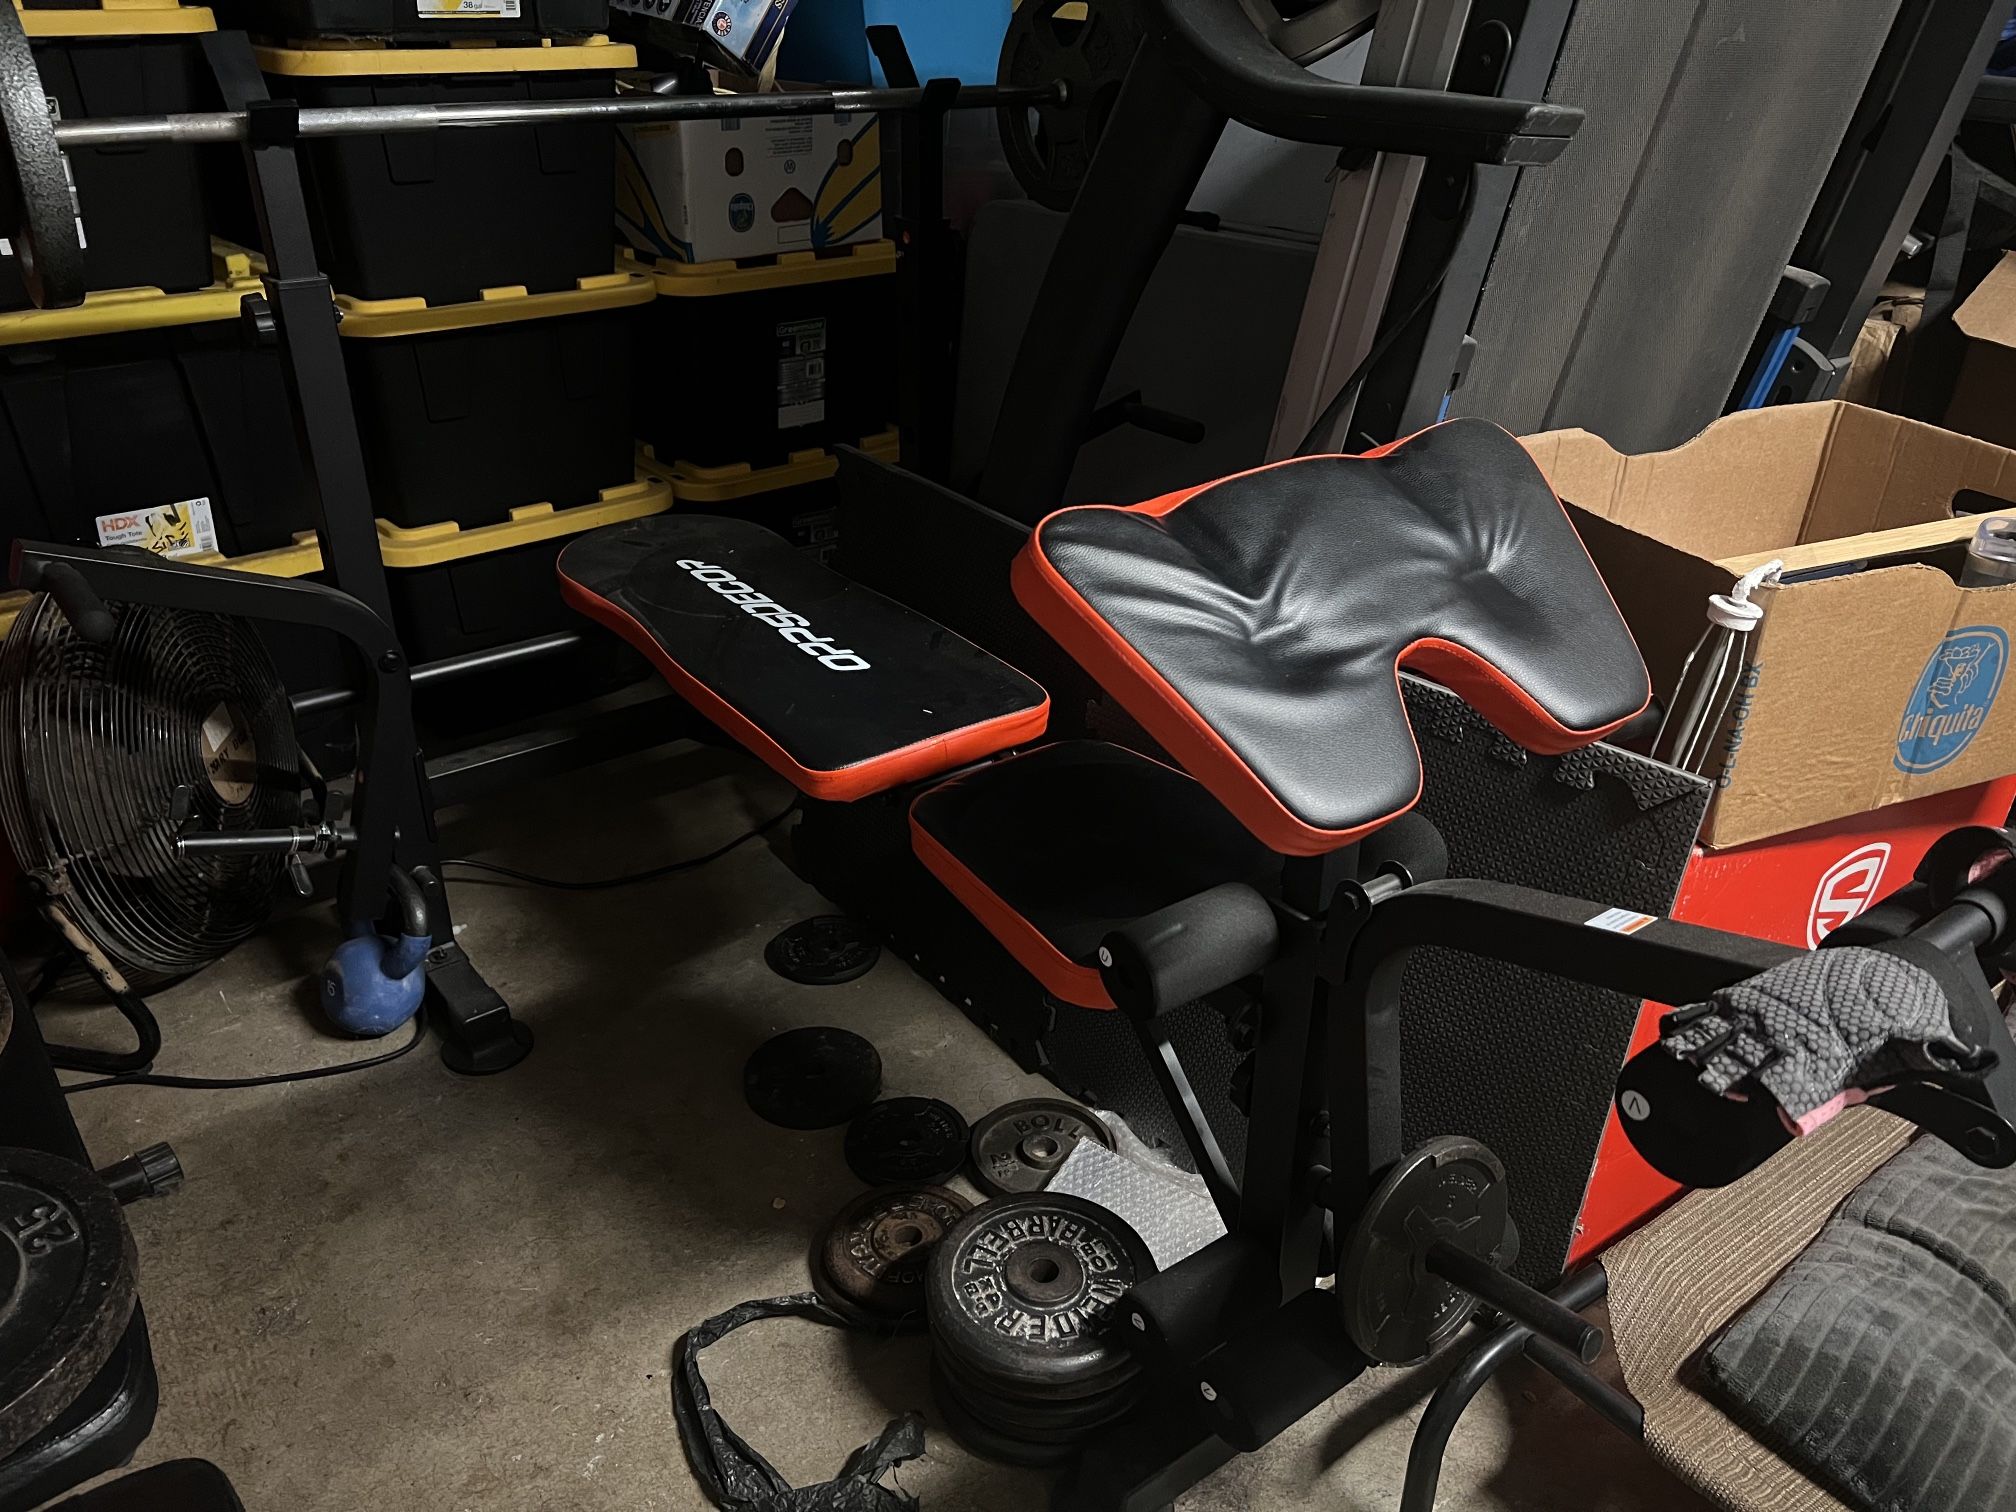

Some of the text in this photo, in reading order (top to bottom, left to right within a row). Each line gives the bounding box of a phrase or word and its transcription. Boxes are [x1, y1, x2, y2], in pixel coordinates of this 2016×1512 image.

[101, 515, 140, 533] HDX
[105, 532, 127, 541] Tough
[676, 558, 871, 672] OPPSDECOR
[1898, 703, 1985, 747] Chiquita
[962, 1215, 1085, 1275] BARBELL
